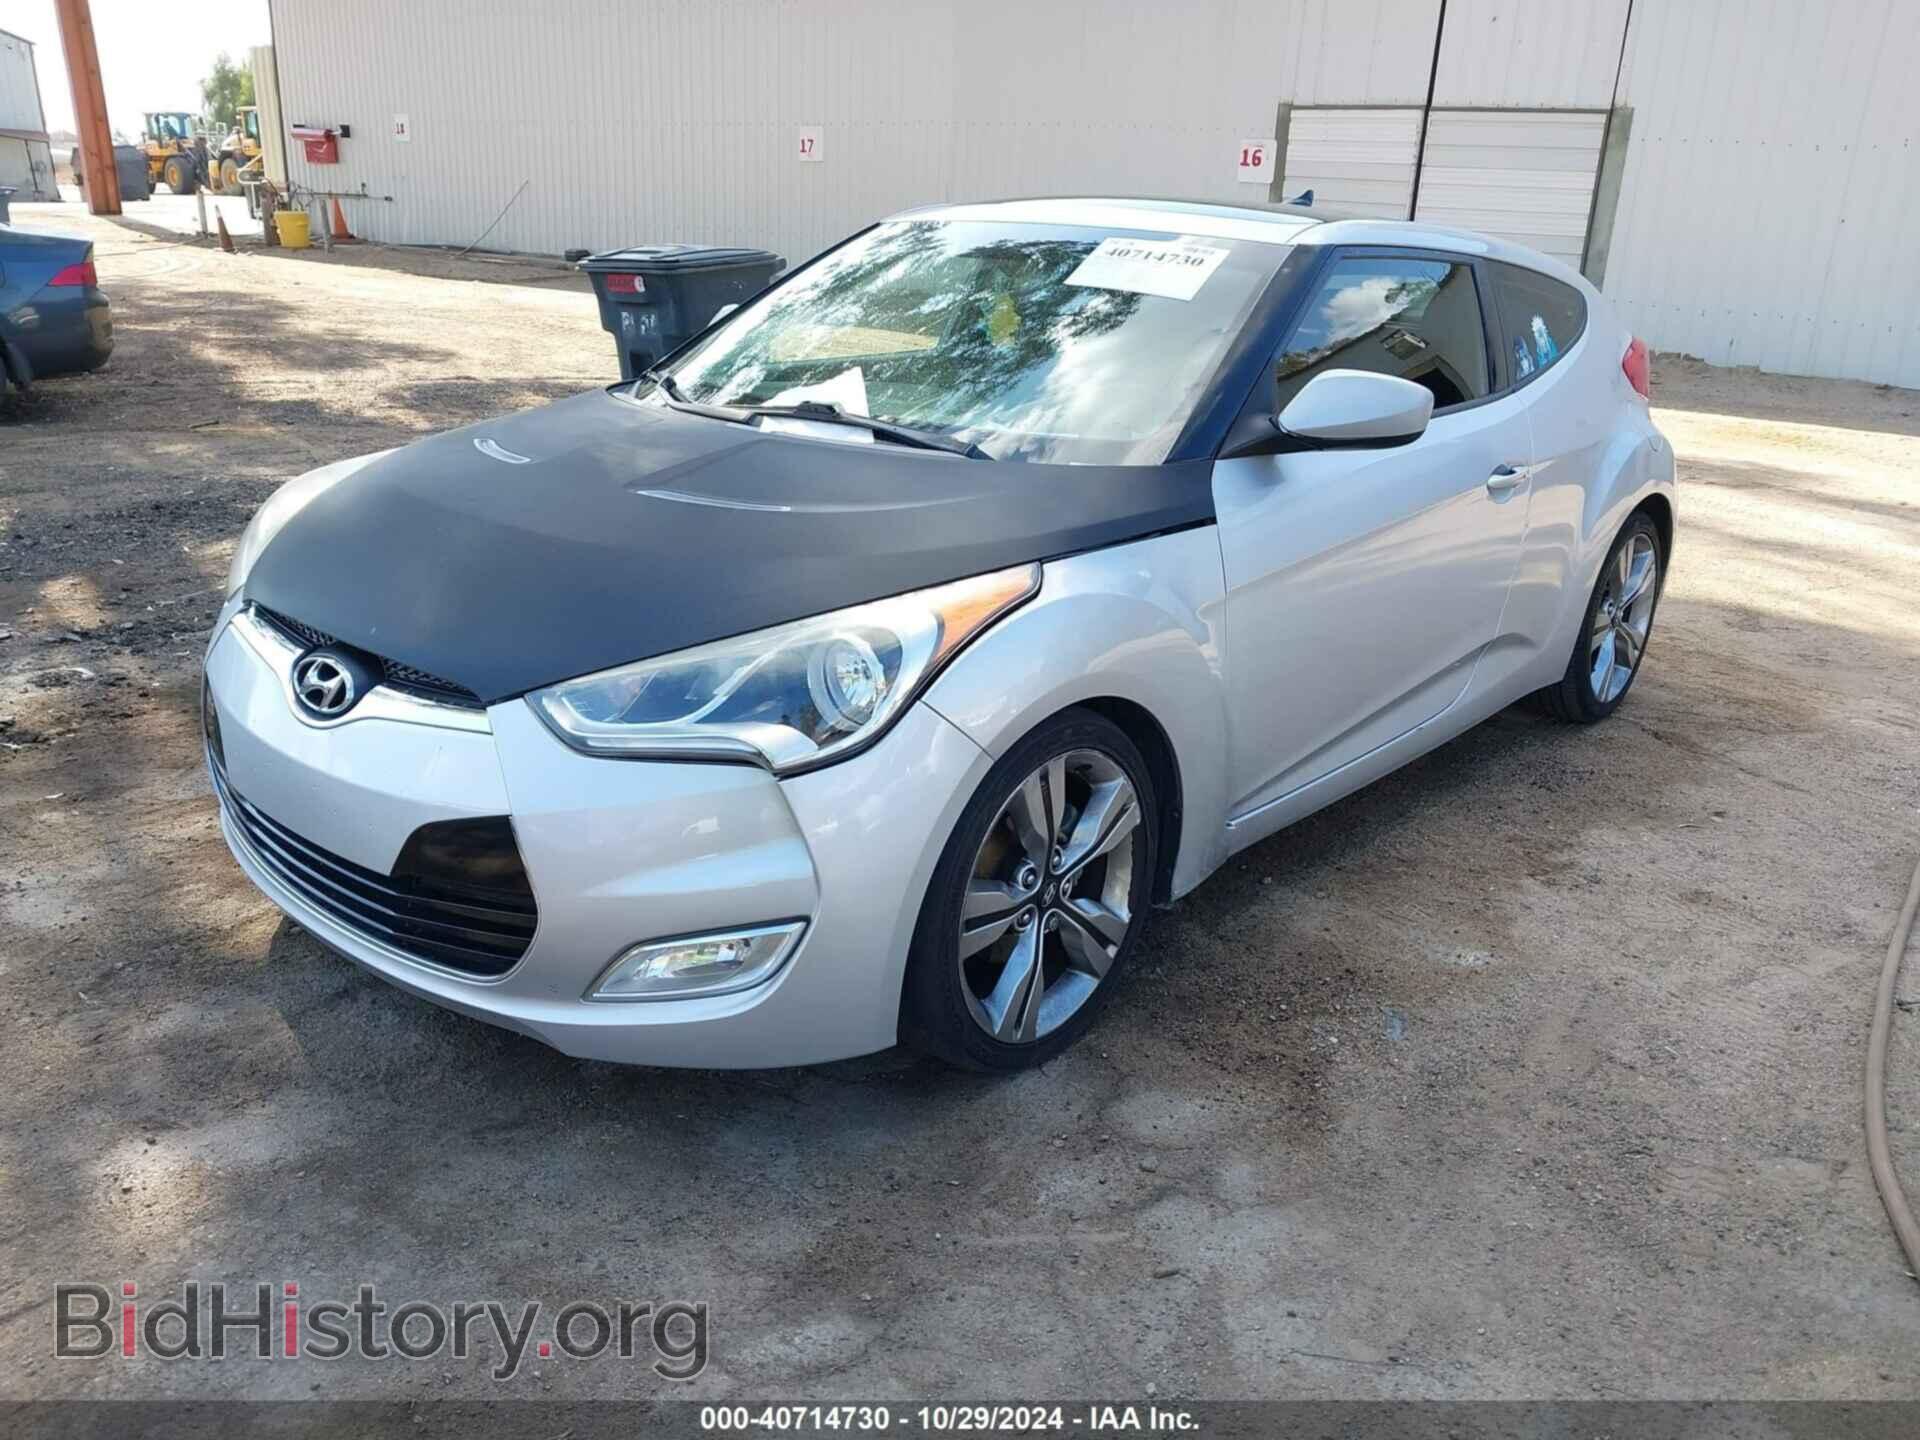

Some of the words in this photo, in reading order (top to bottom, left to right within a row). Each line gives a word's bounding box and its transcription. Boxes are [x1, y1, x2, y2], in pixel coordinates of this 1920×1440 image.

[800, 138, 814, 153] 17
[1240, 148, 1262, 167] 16
[1105, 247, 1205, 266] 40714730
